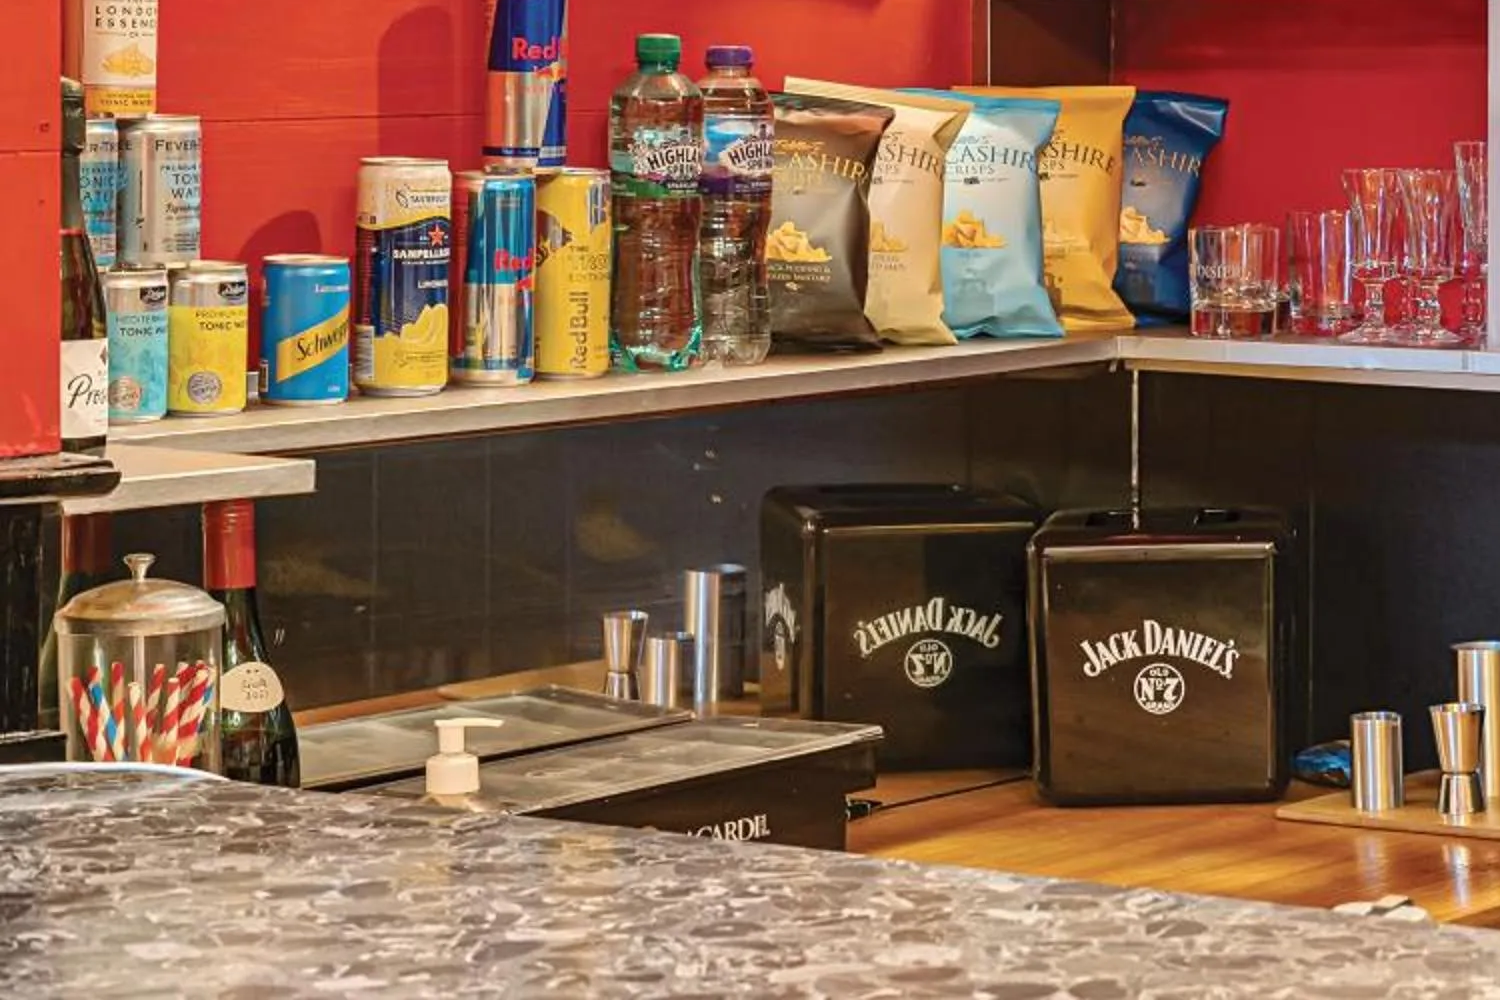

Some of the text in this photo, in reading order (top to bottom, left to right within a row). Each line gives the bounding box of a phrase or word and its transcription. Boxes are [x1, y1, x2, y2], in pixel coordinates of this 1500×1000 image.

[95, 5, 157, 16] LONDO
[95, 17, 155, 29] ESSENC
[512, 37, 557, 60] Red
[155, 138, 199, 152] FEVER-
[648, 148, 698, 171] HIGHLA
[494, 247, 534, 271] Red
[119, 327, 153, 338] TONIC
[296, 318, 349, 361] Schwep
[569, 291, 589, 369] Red Bull
[1080, 619, 1241, 680] JACK DANIEL'S
[1149, 668, 1170, 678] OLD
